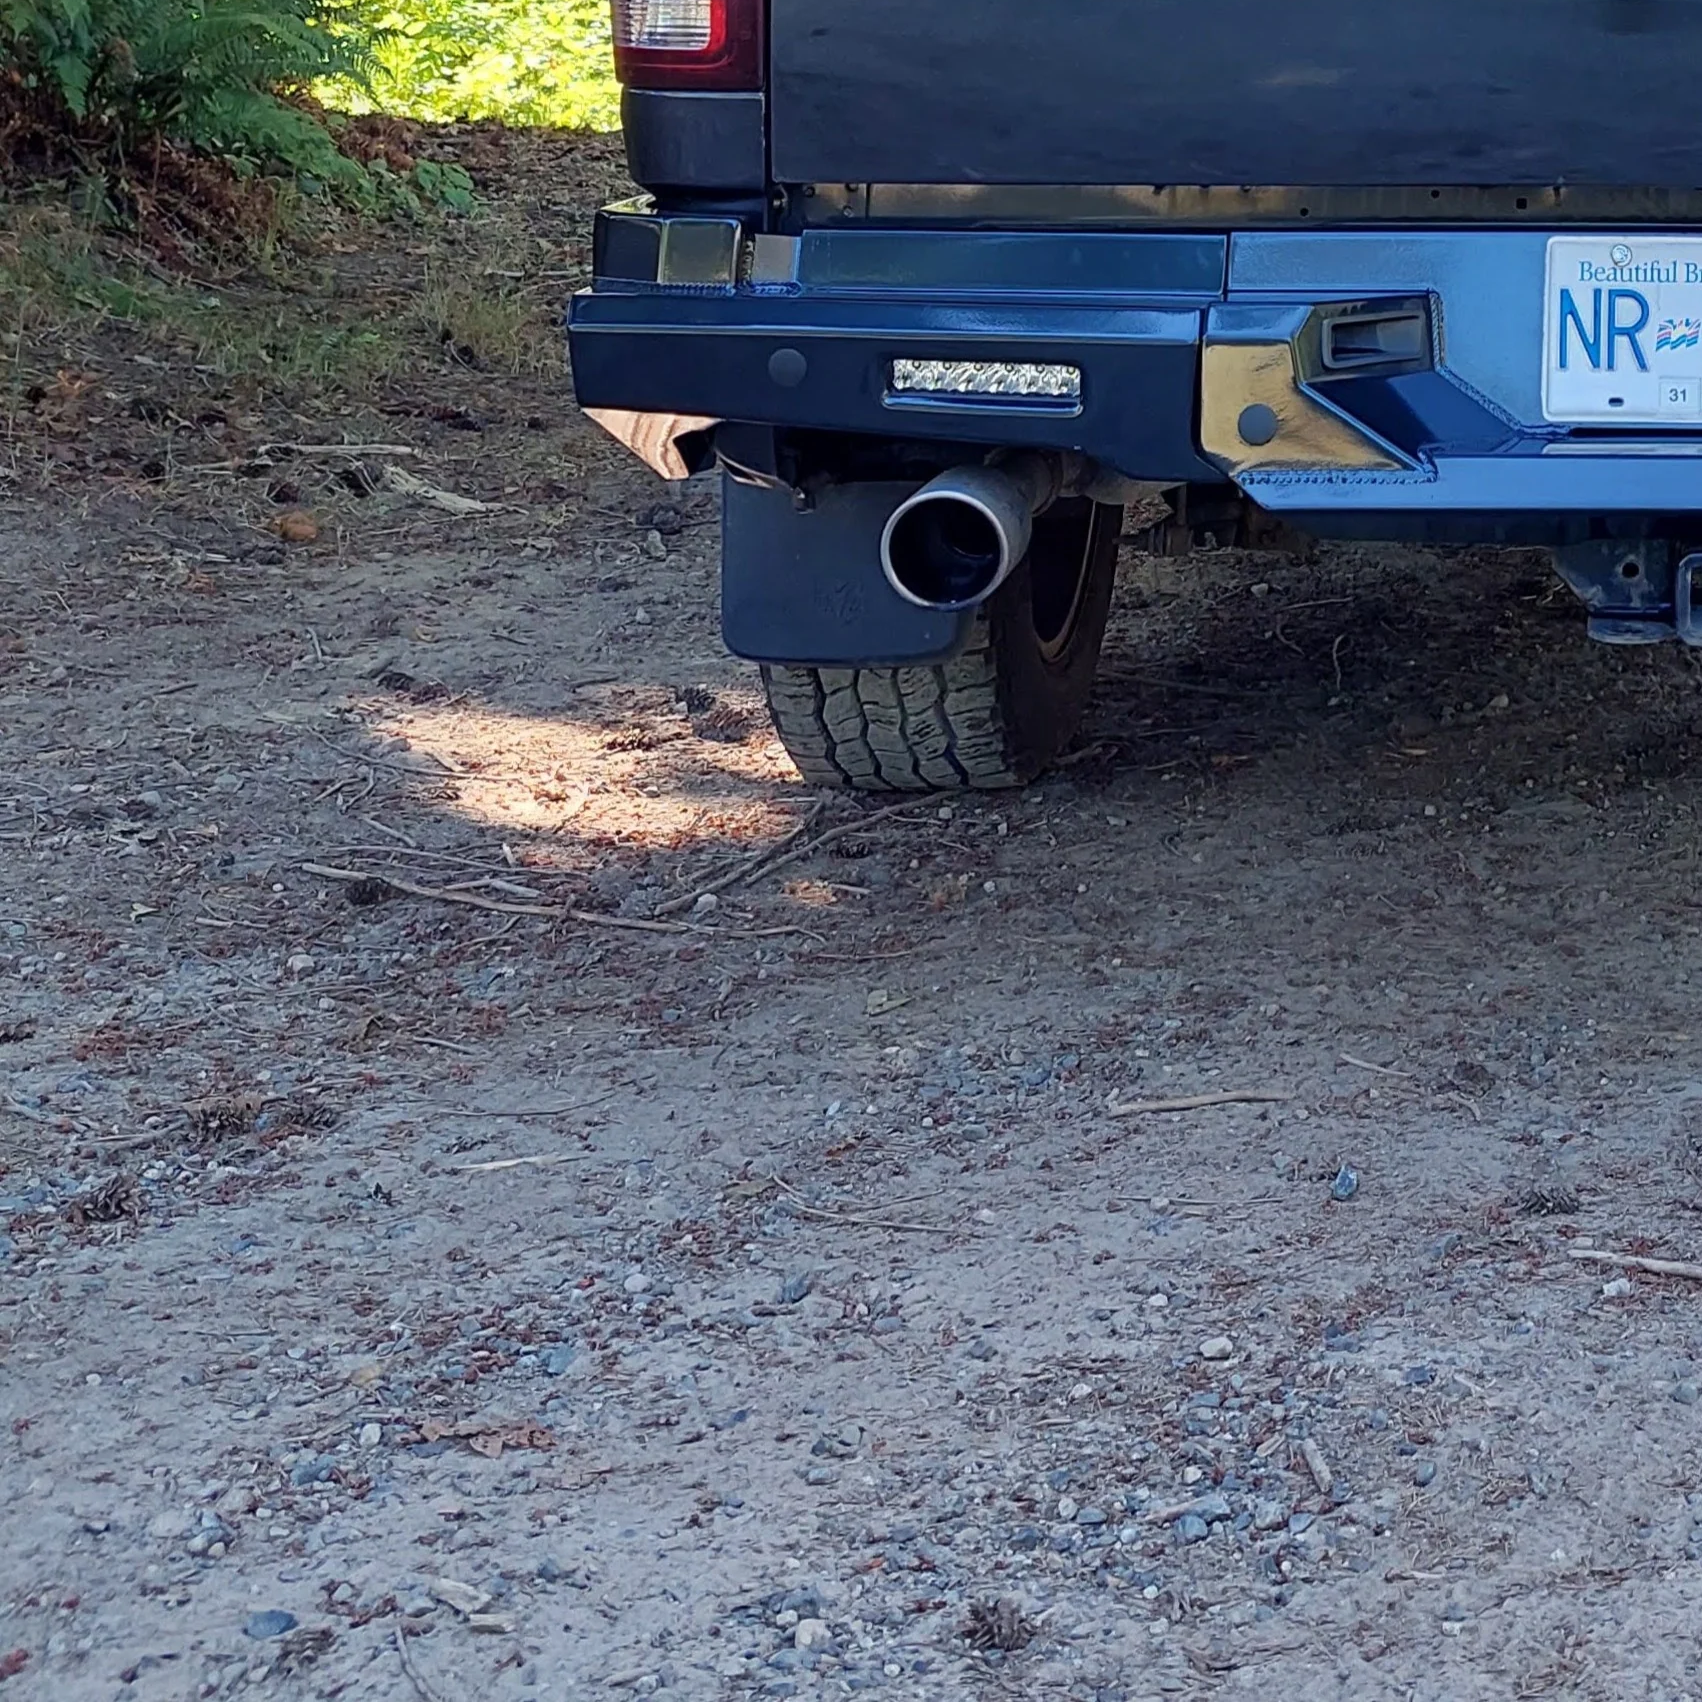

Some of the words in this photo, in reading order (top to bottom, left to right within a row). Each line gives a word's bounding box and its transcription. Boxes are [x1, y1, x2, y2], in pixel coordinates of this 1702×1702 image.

[1578, 261, 1678, 283] Beautiful
[1558, 288, 1650, 371] NR
[1668, 388, 1687, 402] 31
